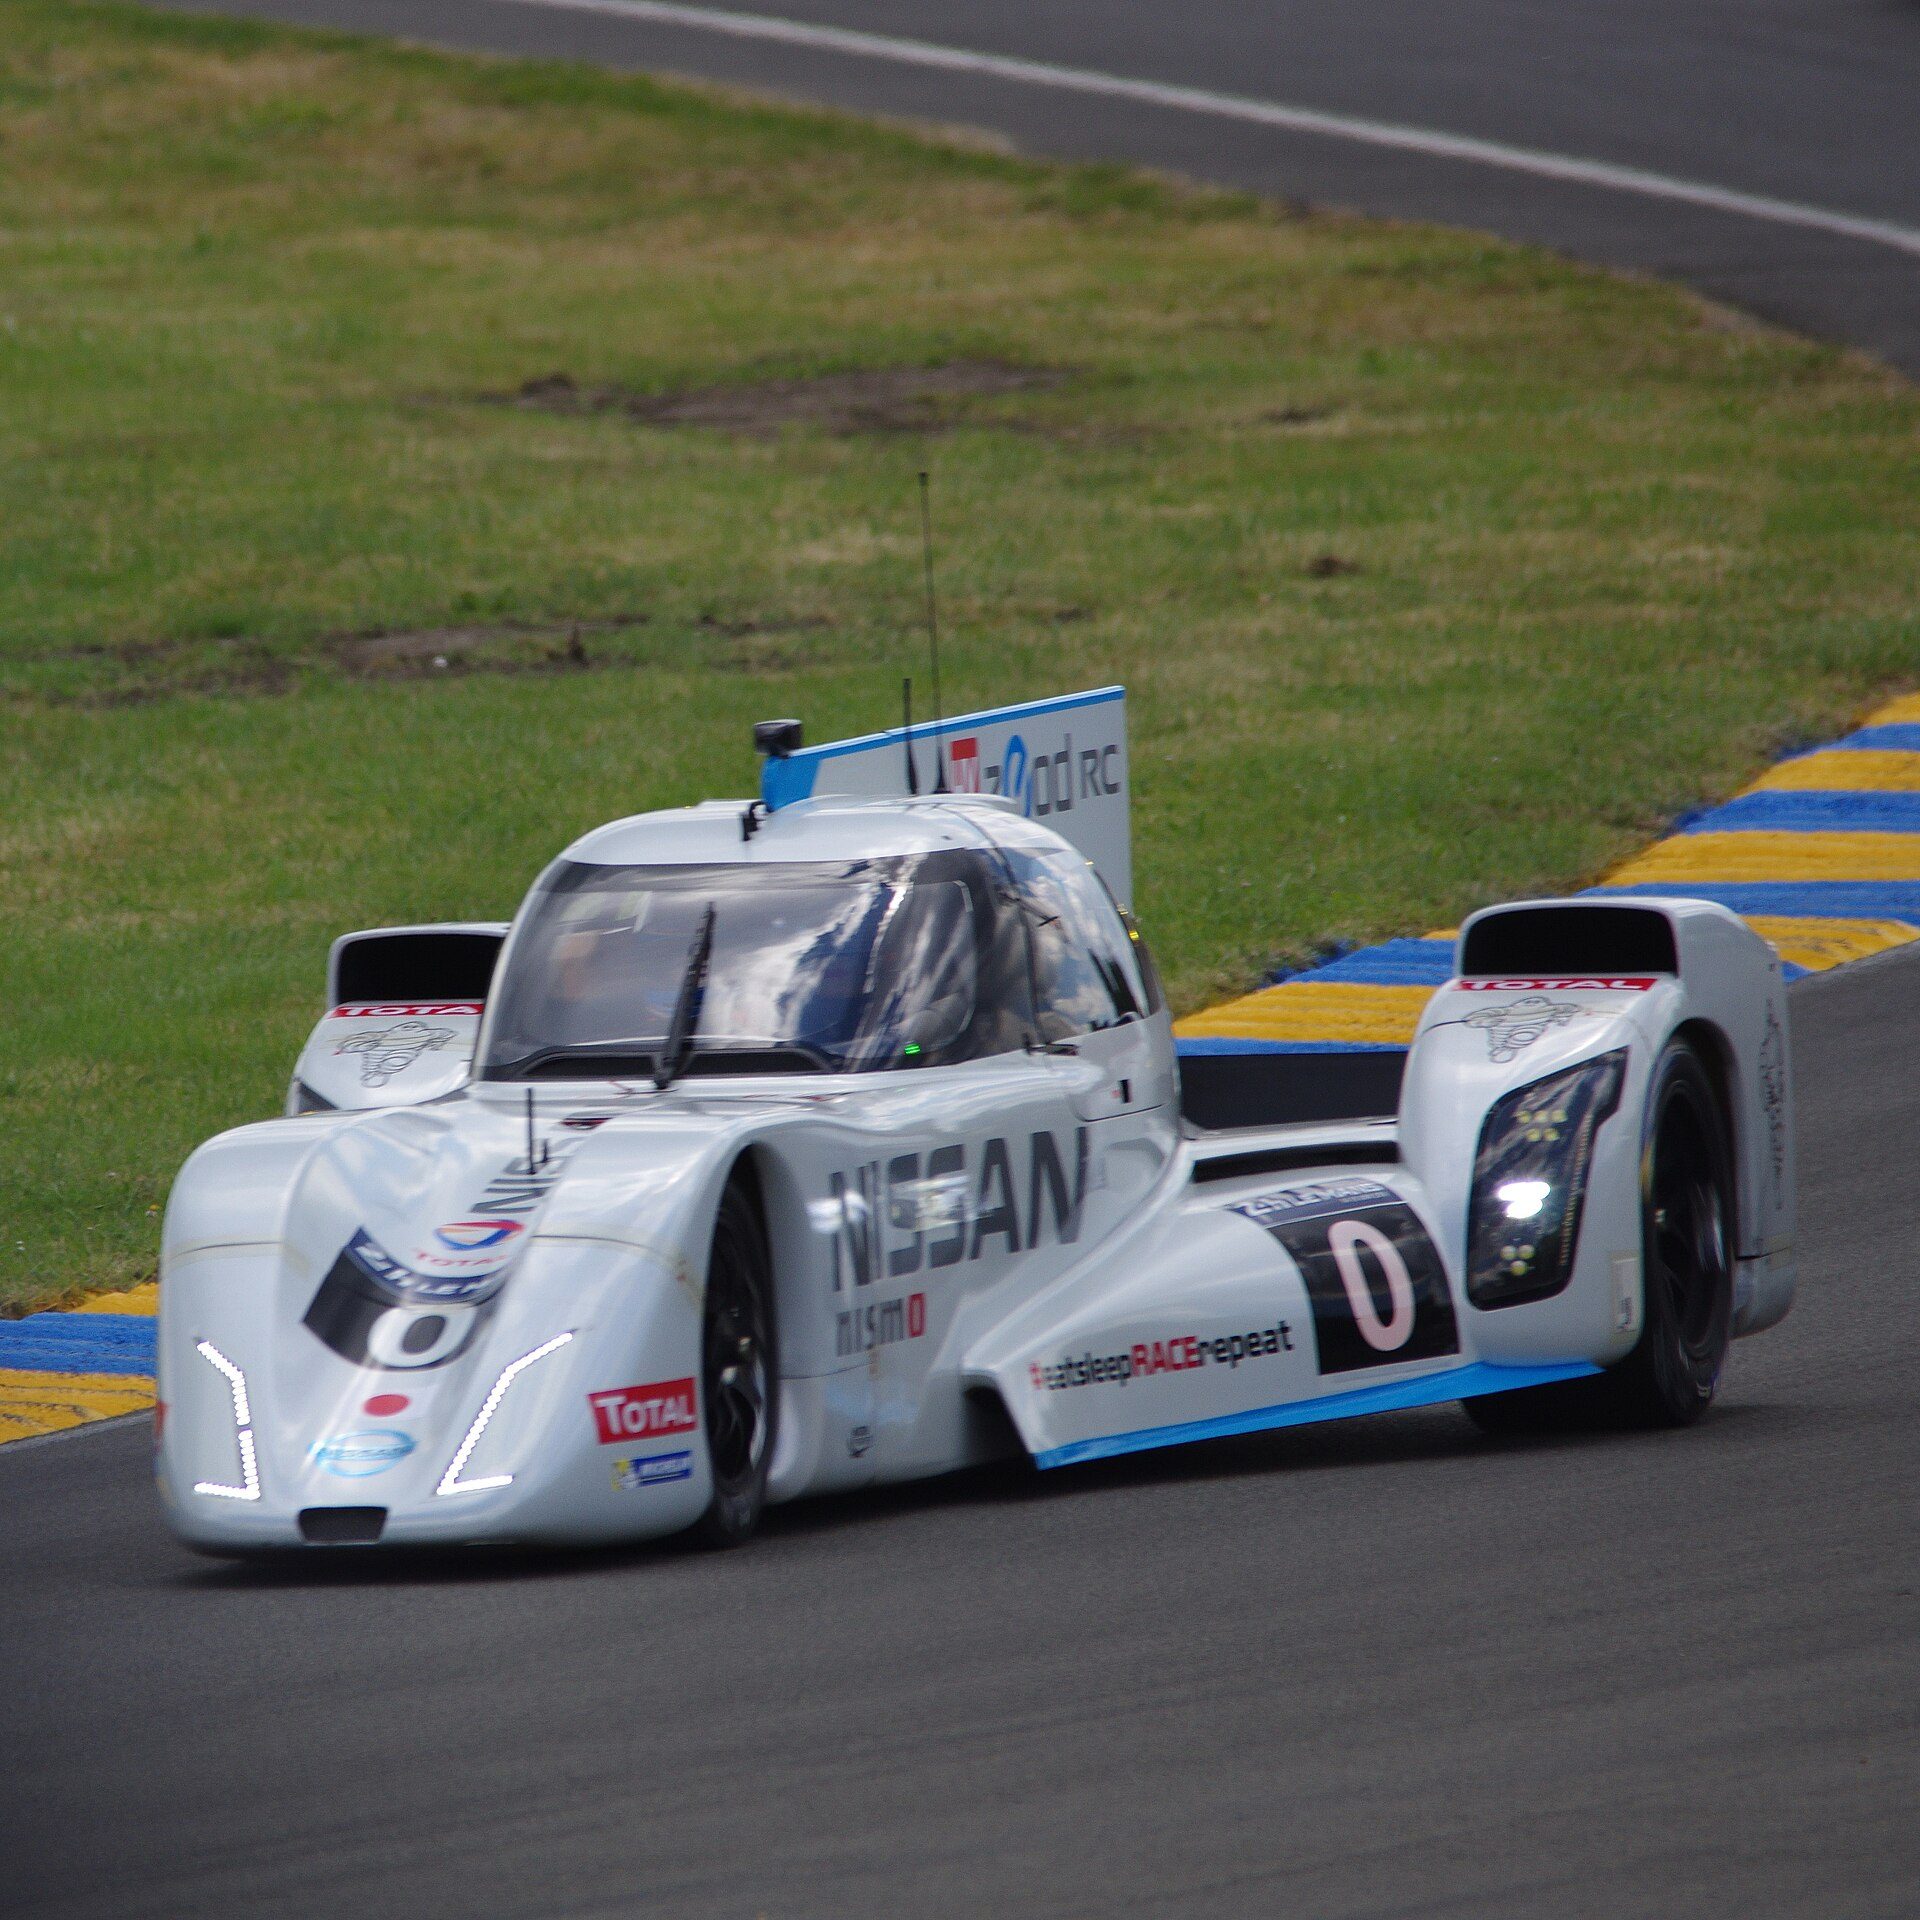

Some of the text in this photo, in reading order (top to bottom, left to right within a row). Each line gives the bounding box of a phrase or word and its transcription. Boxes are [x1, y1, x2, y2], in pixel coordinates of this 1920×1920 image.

[1079, 744, 1121, 798] RC
[341, 1005, 481, 1017] TOTA
[1463, 979, 1643, 991] TOTAL
[829, 1126, 1090, 1293] NISSAN
[1327, 1219, 1417, 1353] 0
[366, 1304, 480, 1369] 0
[593, 1394, 697, 1436] TOTAL
